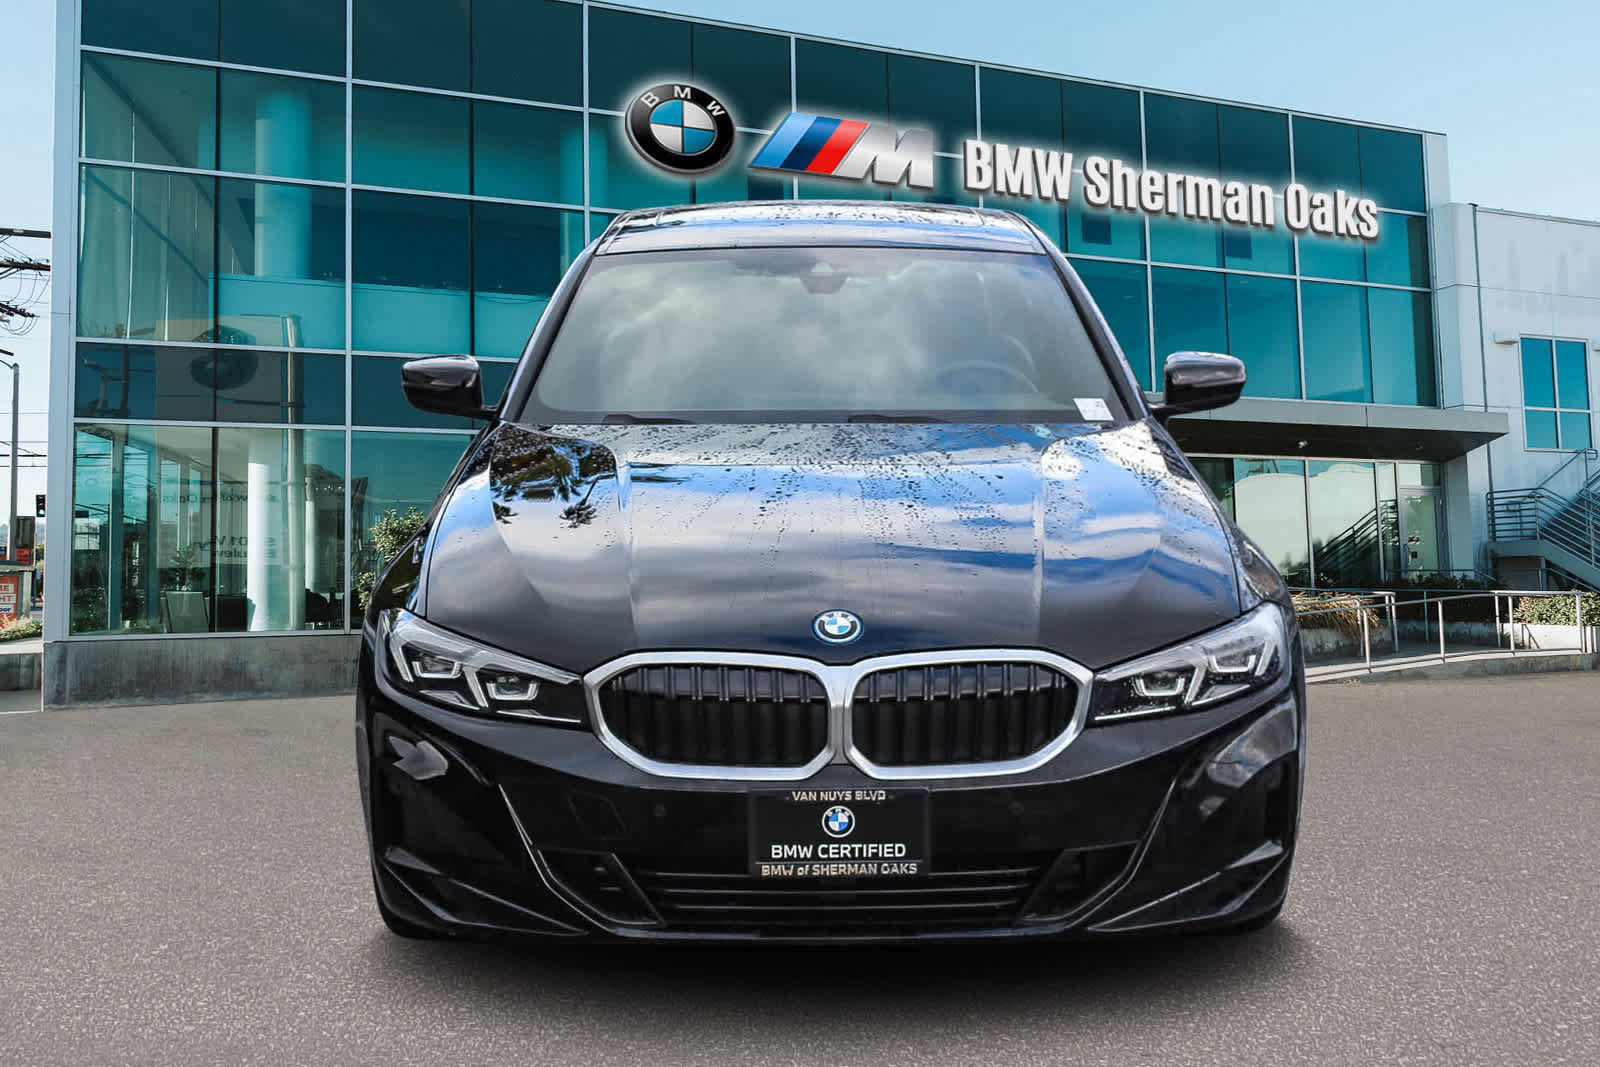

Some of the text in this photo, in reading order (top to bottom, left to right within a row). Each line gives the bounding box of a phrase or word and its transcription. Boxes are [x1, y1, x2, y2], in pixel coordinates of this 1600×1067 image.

[641, 85, 726, 117] BMW
[964, 138, 1379, 240] BMW Sherman Oaks
[792, 790, 886, 801] VAN NUYS BLVD
[771, 843, 906, 858] BMW CERTIFIED
[761, 863, 918, 876] BMW of SHERMAN OAKS
